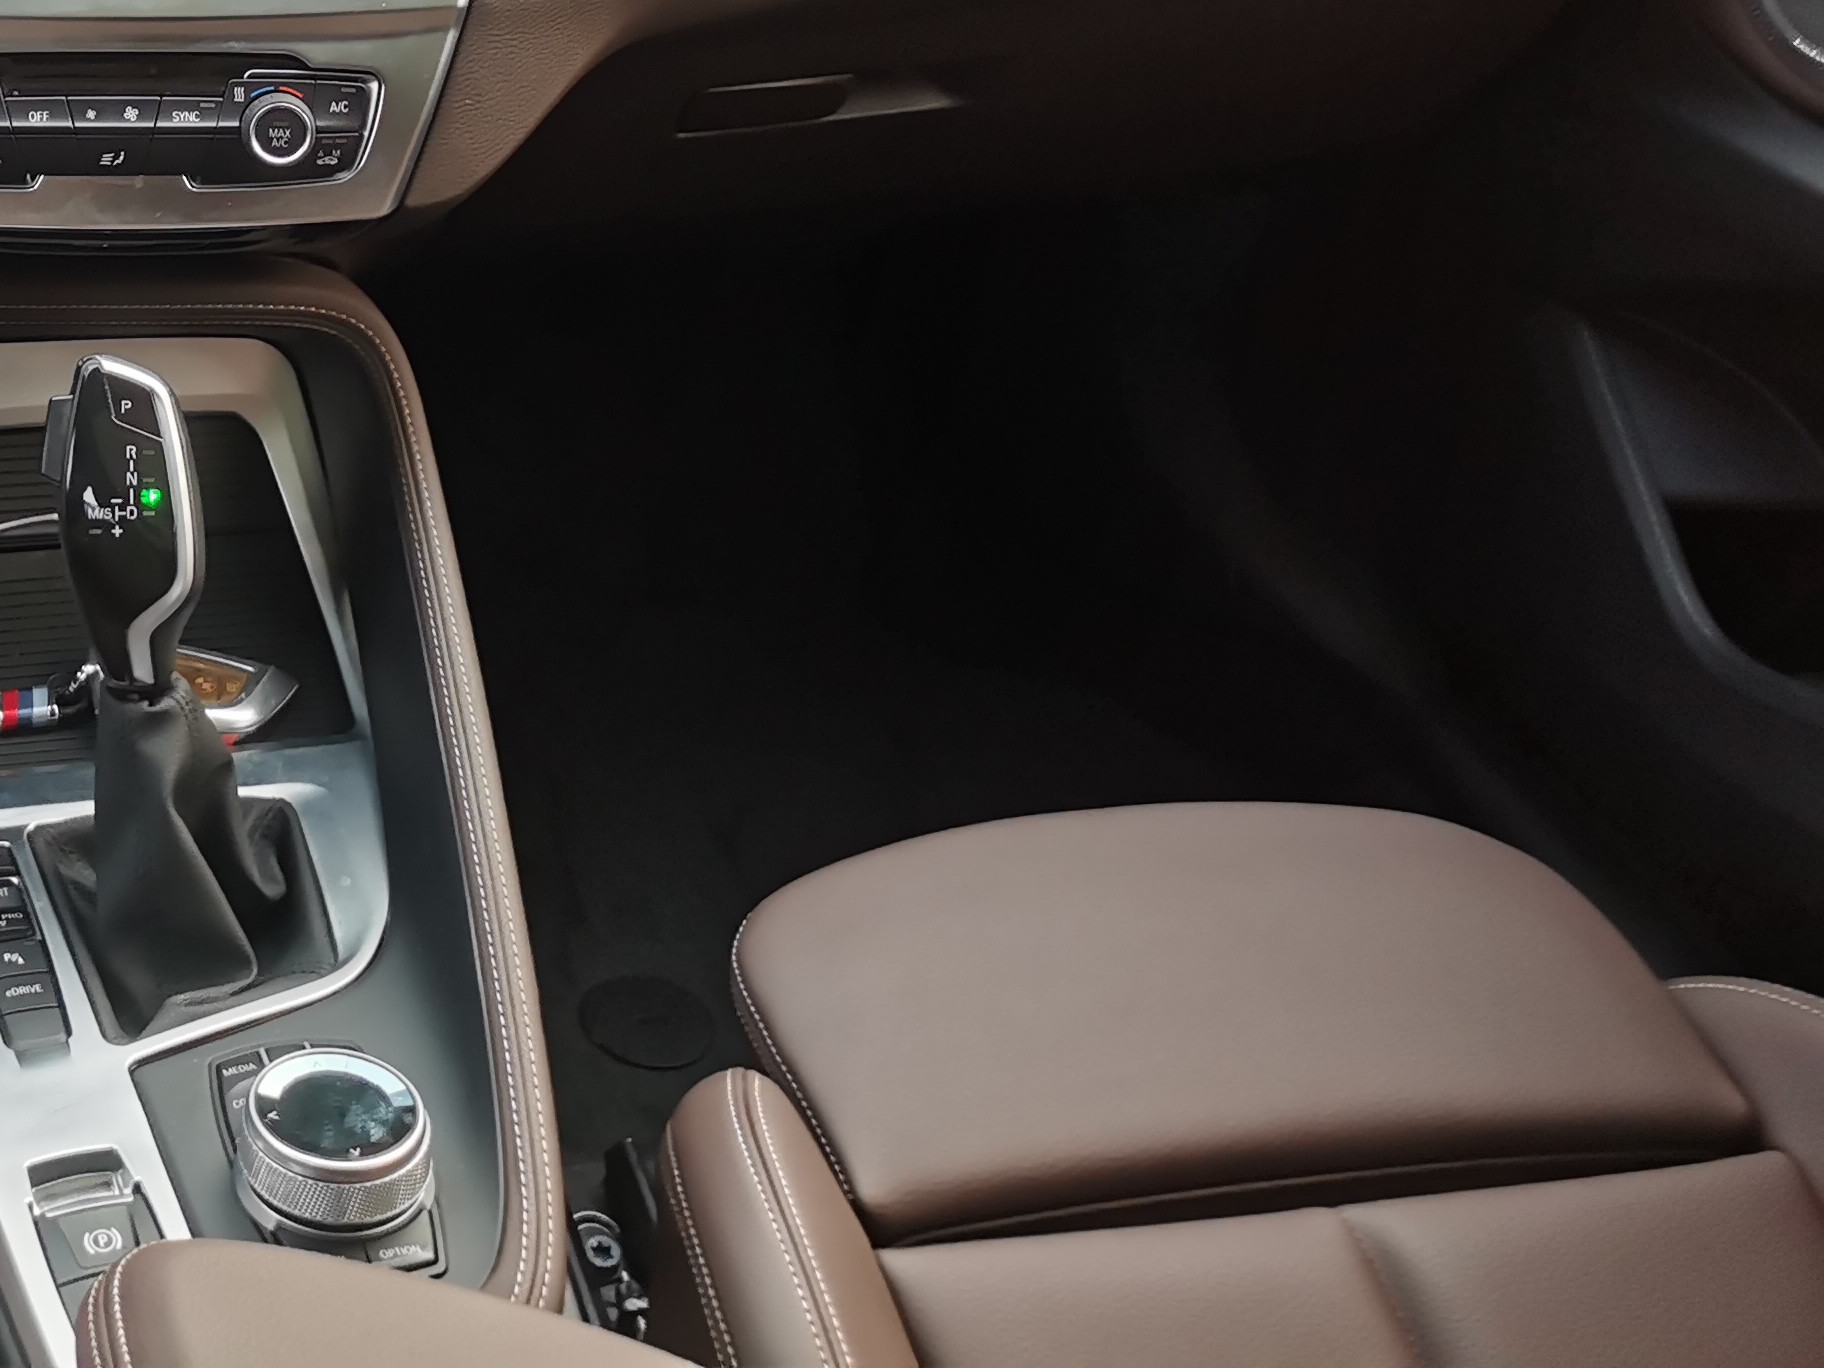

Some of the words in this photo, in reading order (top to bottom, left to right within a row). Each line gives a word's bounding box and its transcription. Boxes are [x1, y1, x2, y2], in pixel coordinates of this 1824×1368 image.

[328, 99, 351, 114] A/C
[27, 109, 51, 124] OFF
[171, 109, 202, 125] SYNC
[268, 126, 292, 138] MAX
[271, 136, 290, 148] A/C
[120, 399, 133, 415] P
[125, 444, 138, 460] R
[126, 470, 139, 487] N
[88, 506, 113, 521] M/S
[126, 505, 139, 521] D
[1, 911, 24, 920] PRO
[5, 983, 45, 997] eDRIVE
[221, 1060, 259, 1078] MEDIA
[97, 1233, 109, 1249] P
[378, 1243, 423, 1260] OPTION
